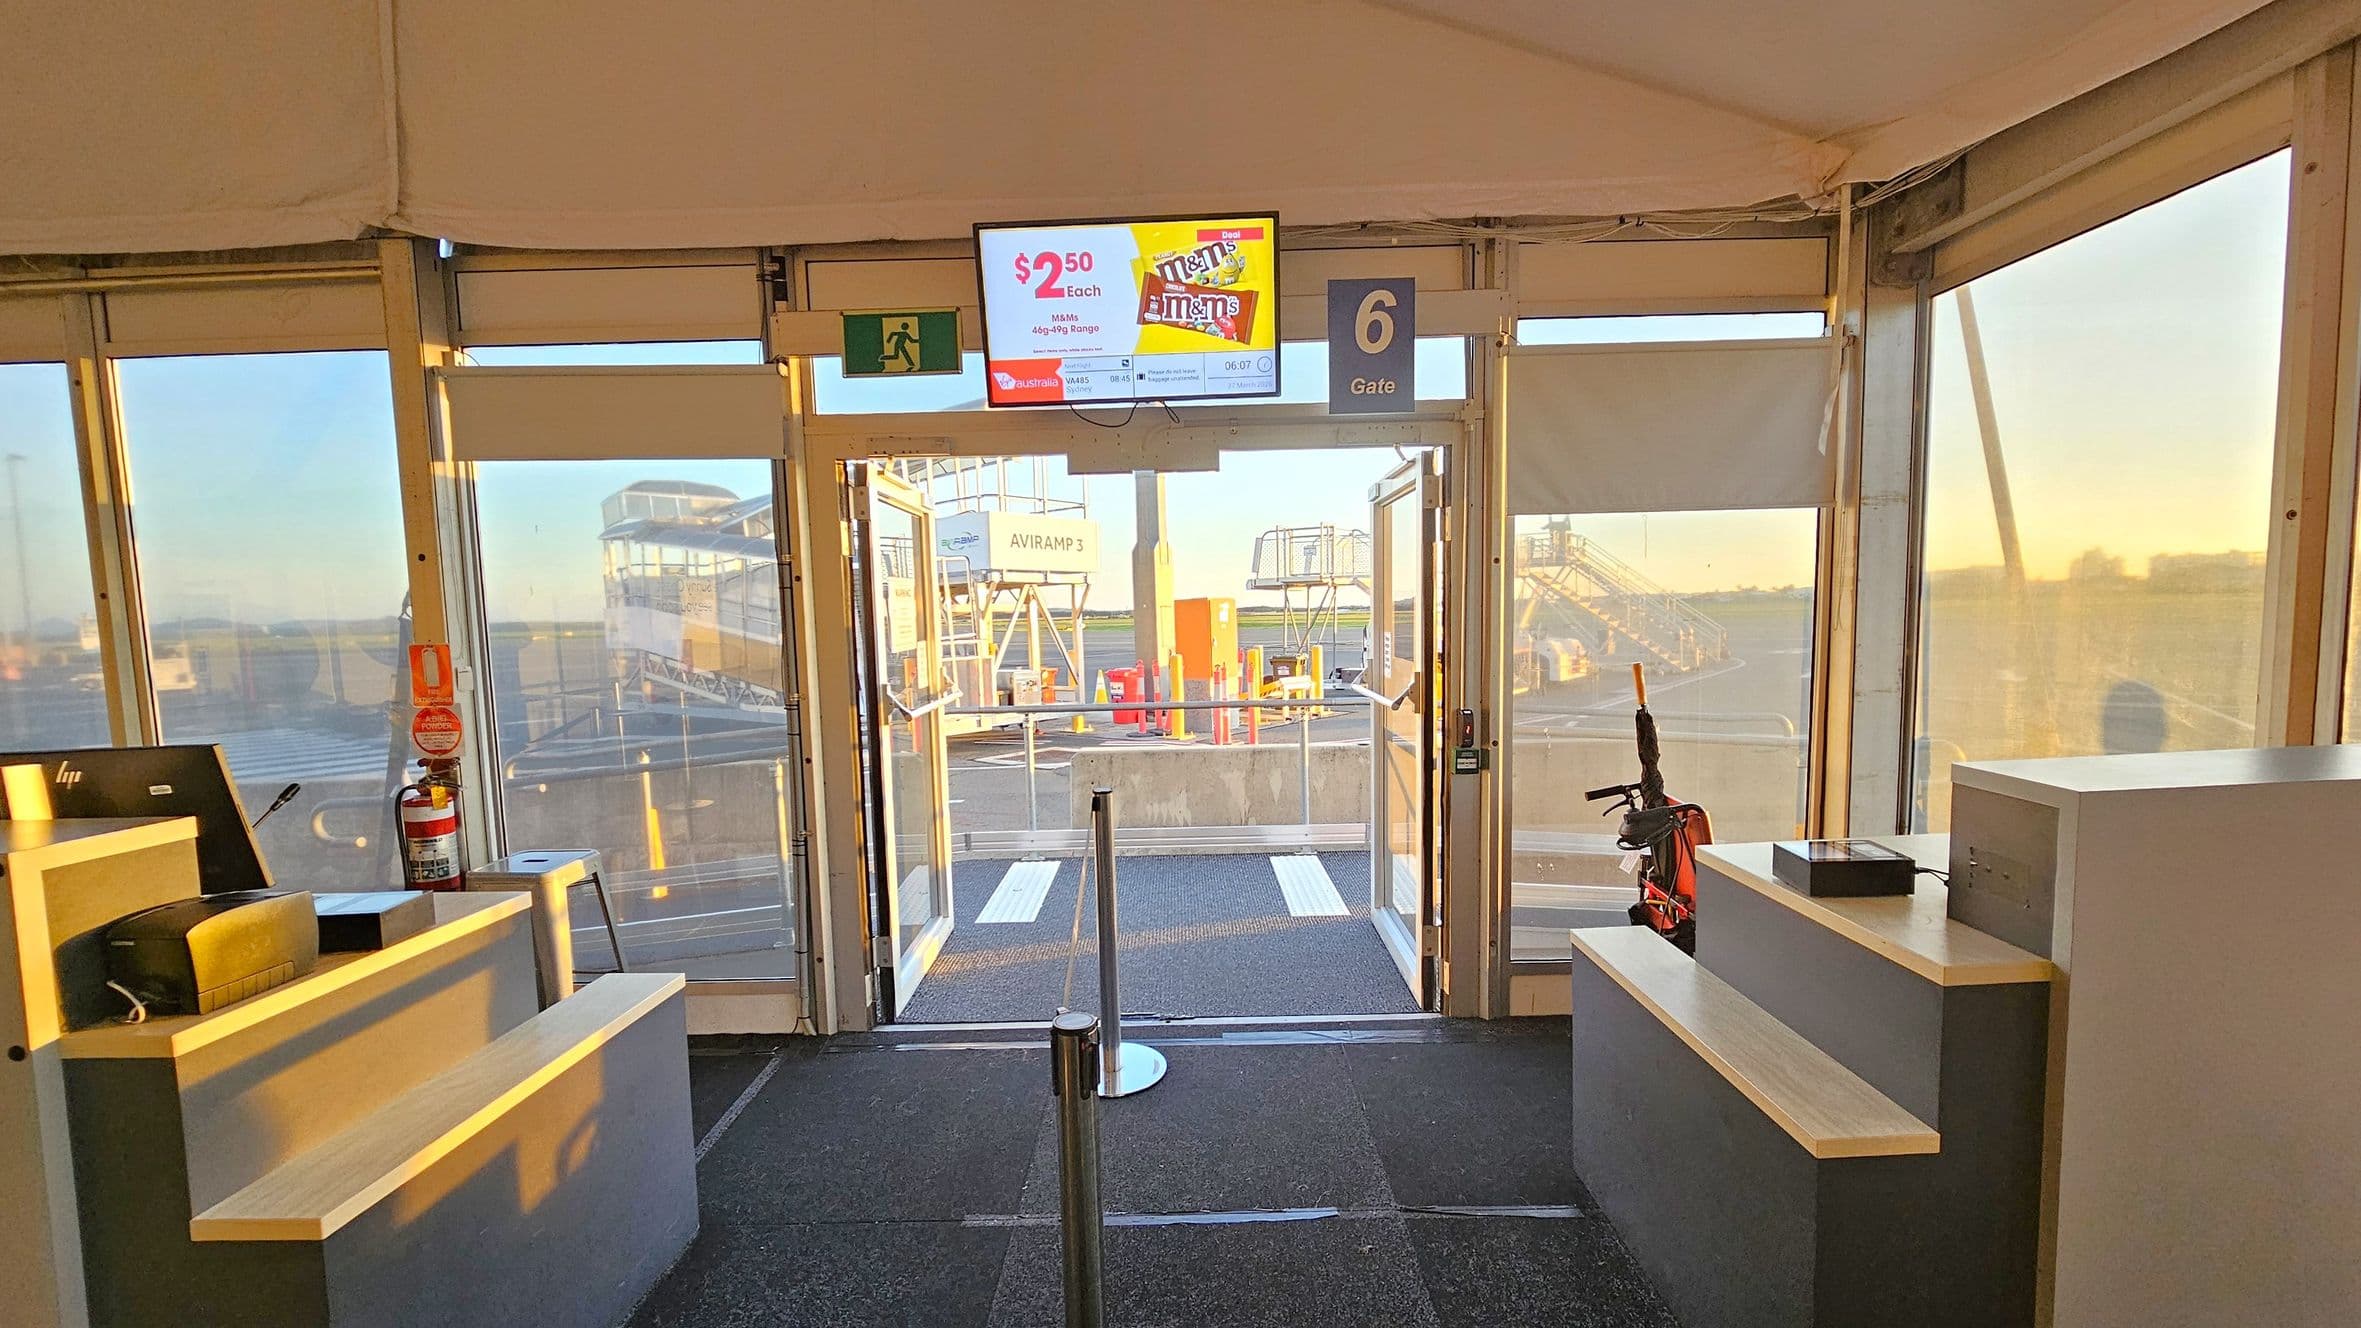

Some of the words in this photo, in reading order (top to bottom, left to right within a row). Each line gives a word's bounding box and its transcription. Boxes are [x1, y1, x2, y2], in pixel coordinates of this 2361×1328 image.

[1221, 231, 1241, 239] Deal
[1067, 284, 1101, 298] Each
[1051, 313, 1079, 322] M&Ms
[1355, 289, 1397, 354] 6
[1032, 325, 1068, 336] 46g-49g
[1070, 324, 1100, 334] Range
[1225, 360, 1251, 370] 06:07
[1017, 378, 1059, 389] australia
[1066, 375, 1090, 384] VA485
[1110, 374, 1131, 383] 08:45
[1066, 385, 1093, 394] Sydney
[1350, 377, 1396, 395] Gate
[1010, 533, 1073, 551] AVIRAMP
[1075, 539, 1084, 552] 3
[421, 722, 452, 731] POWDER
[56, 760, 82, 790] hp
